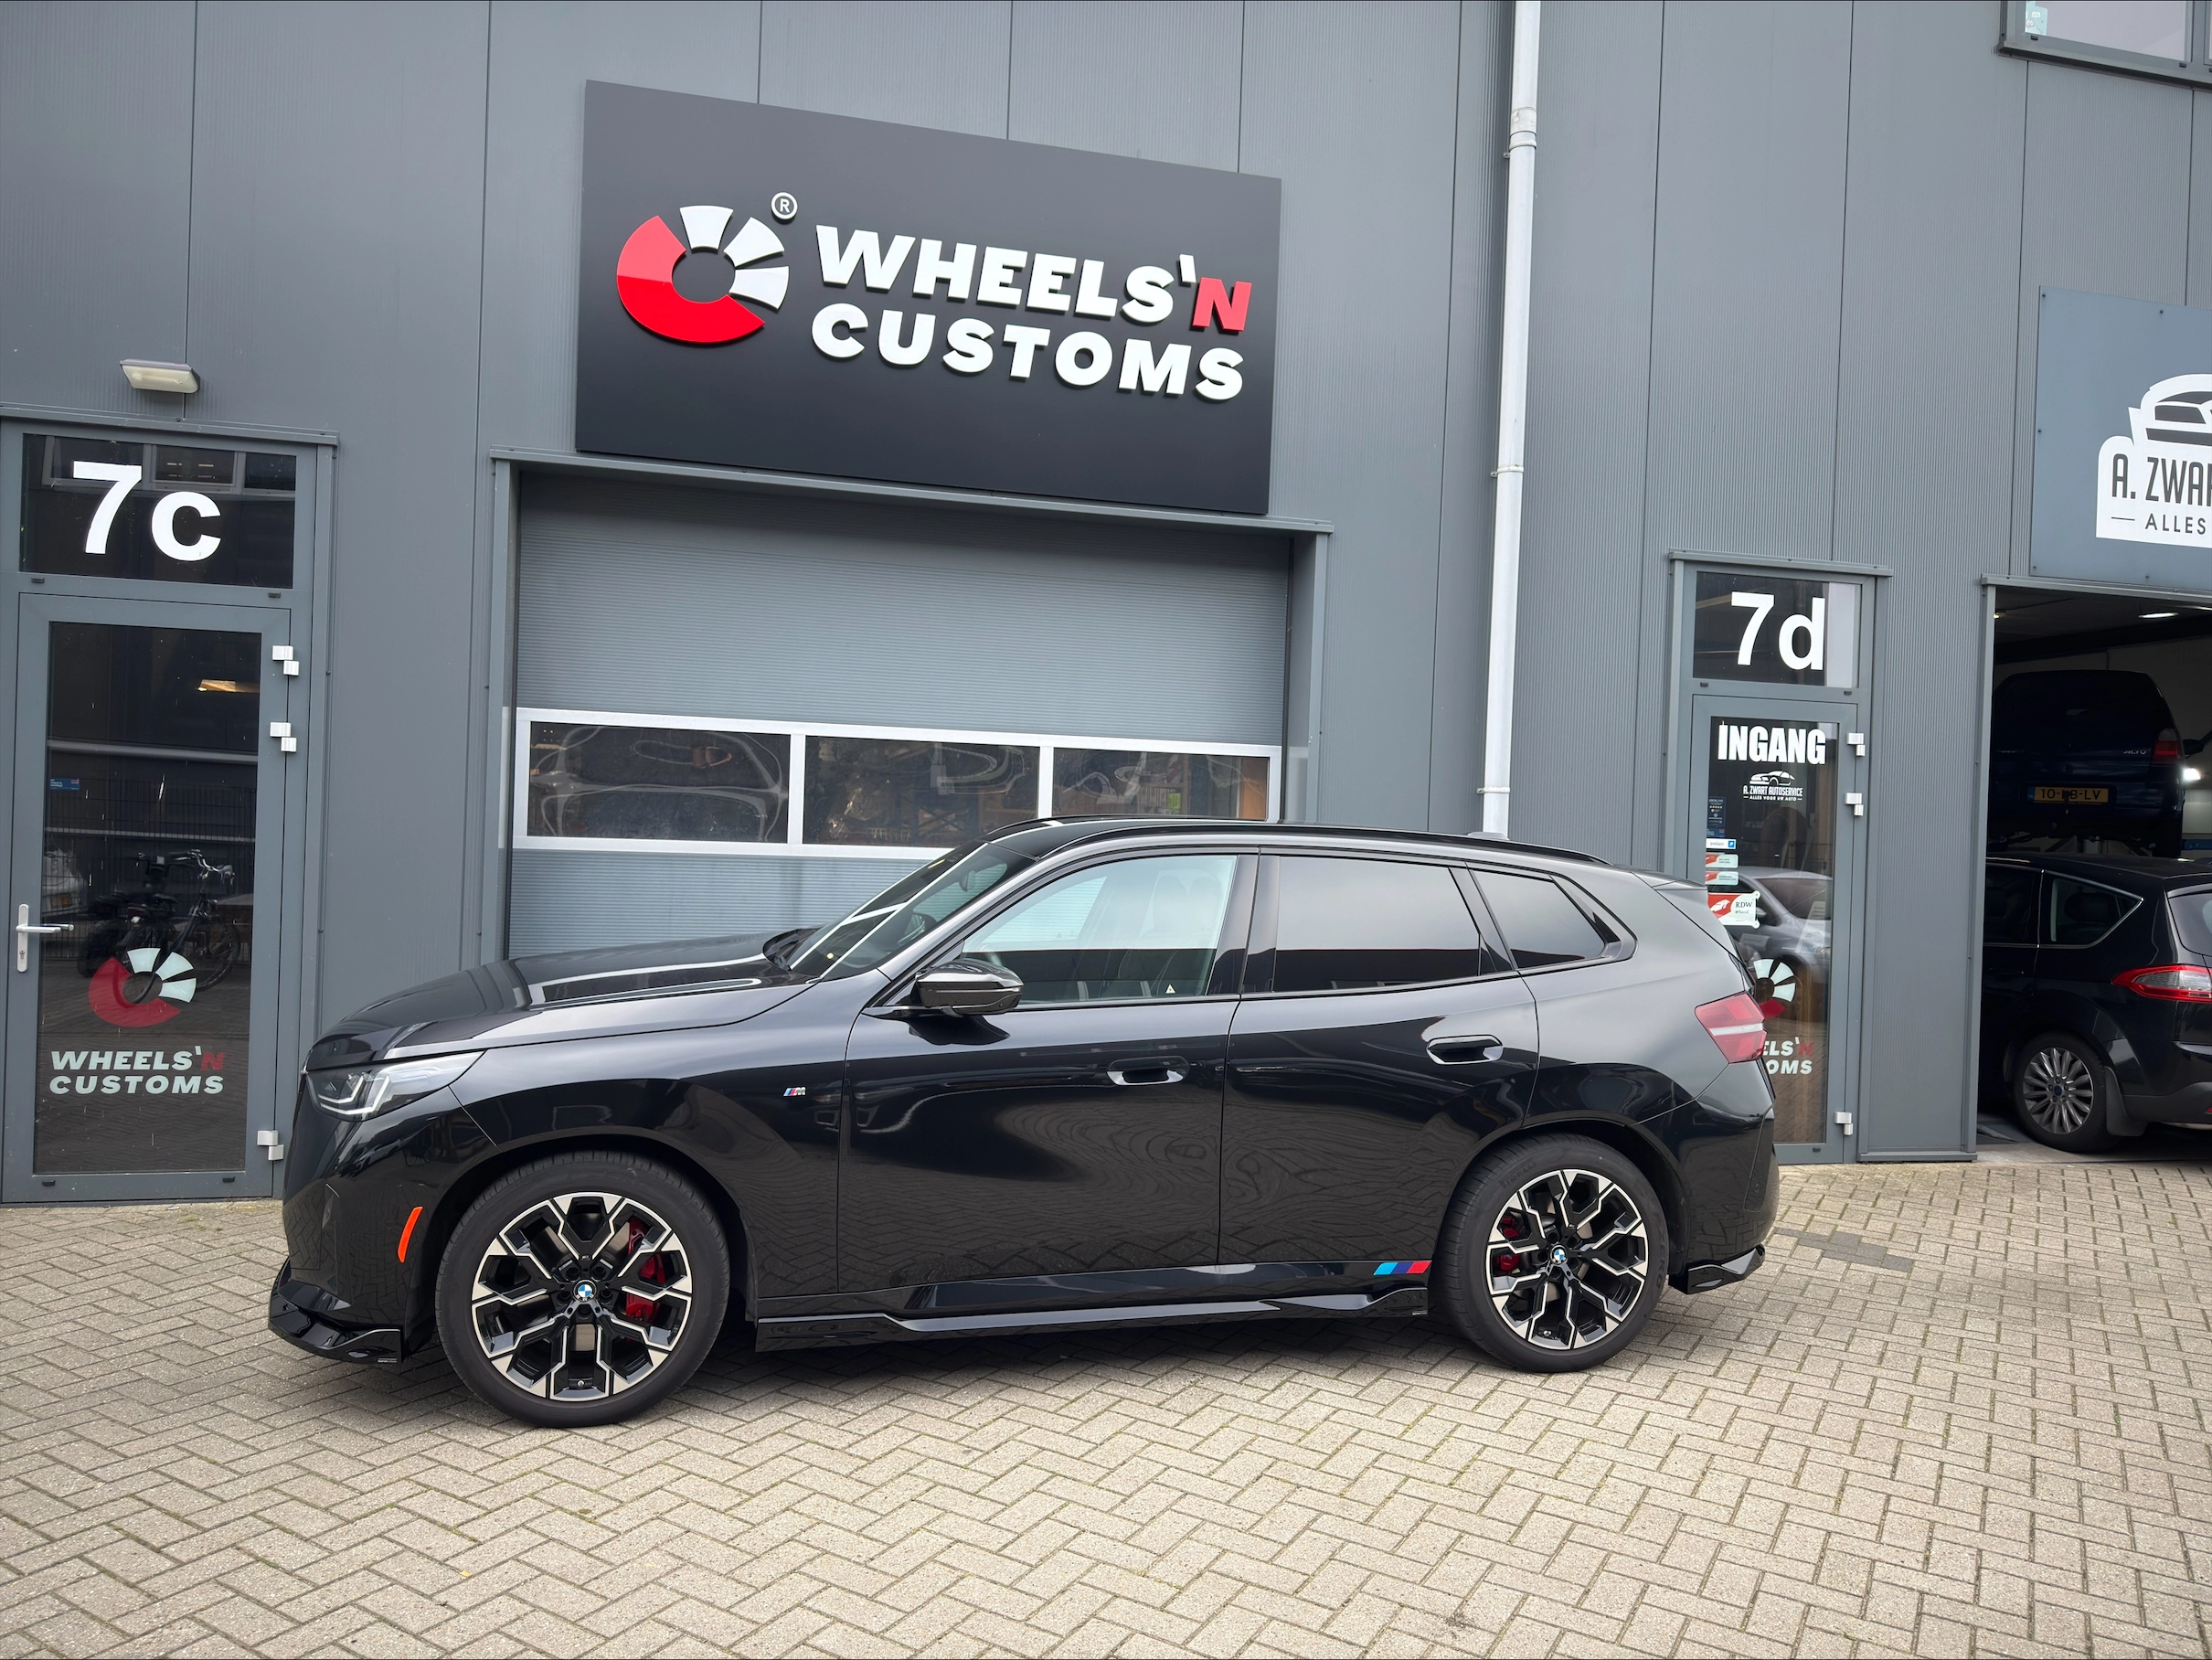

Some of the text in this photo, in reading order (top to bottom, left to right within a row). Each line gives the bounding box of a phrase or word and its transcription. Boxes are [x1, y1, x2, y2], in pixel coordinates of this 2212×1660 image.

[811, 303, 1244, 400] CUSTOMS
[2111, 453, 2136, 499] A.
[2145, 513, 2206, 535] ALLES
[1717, 724, 1826, 764] INGANG
[1749, 786, 1768, 795] ZWART
[1768, 786, 1803, 796] AUTOSERVICE
[2041, 788, 2100, 801] 10-B-LV
[49, 1075, 224, 1095] CUSTOMS
